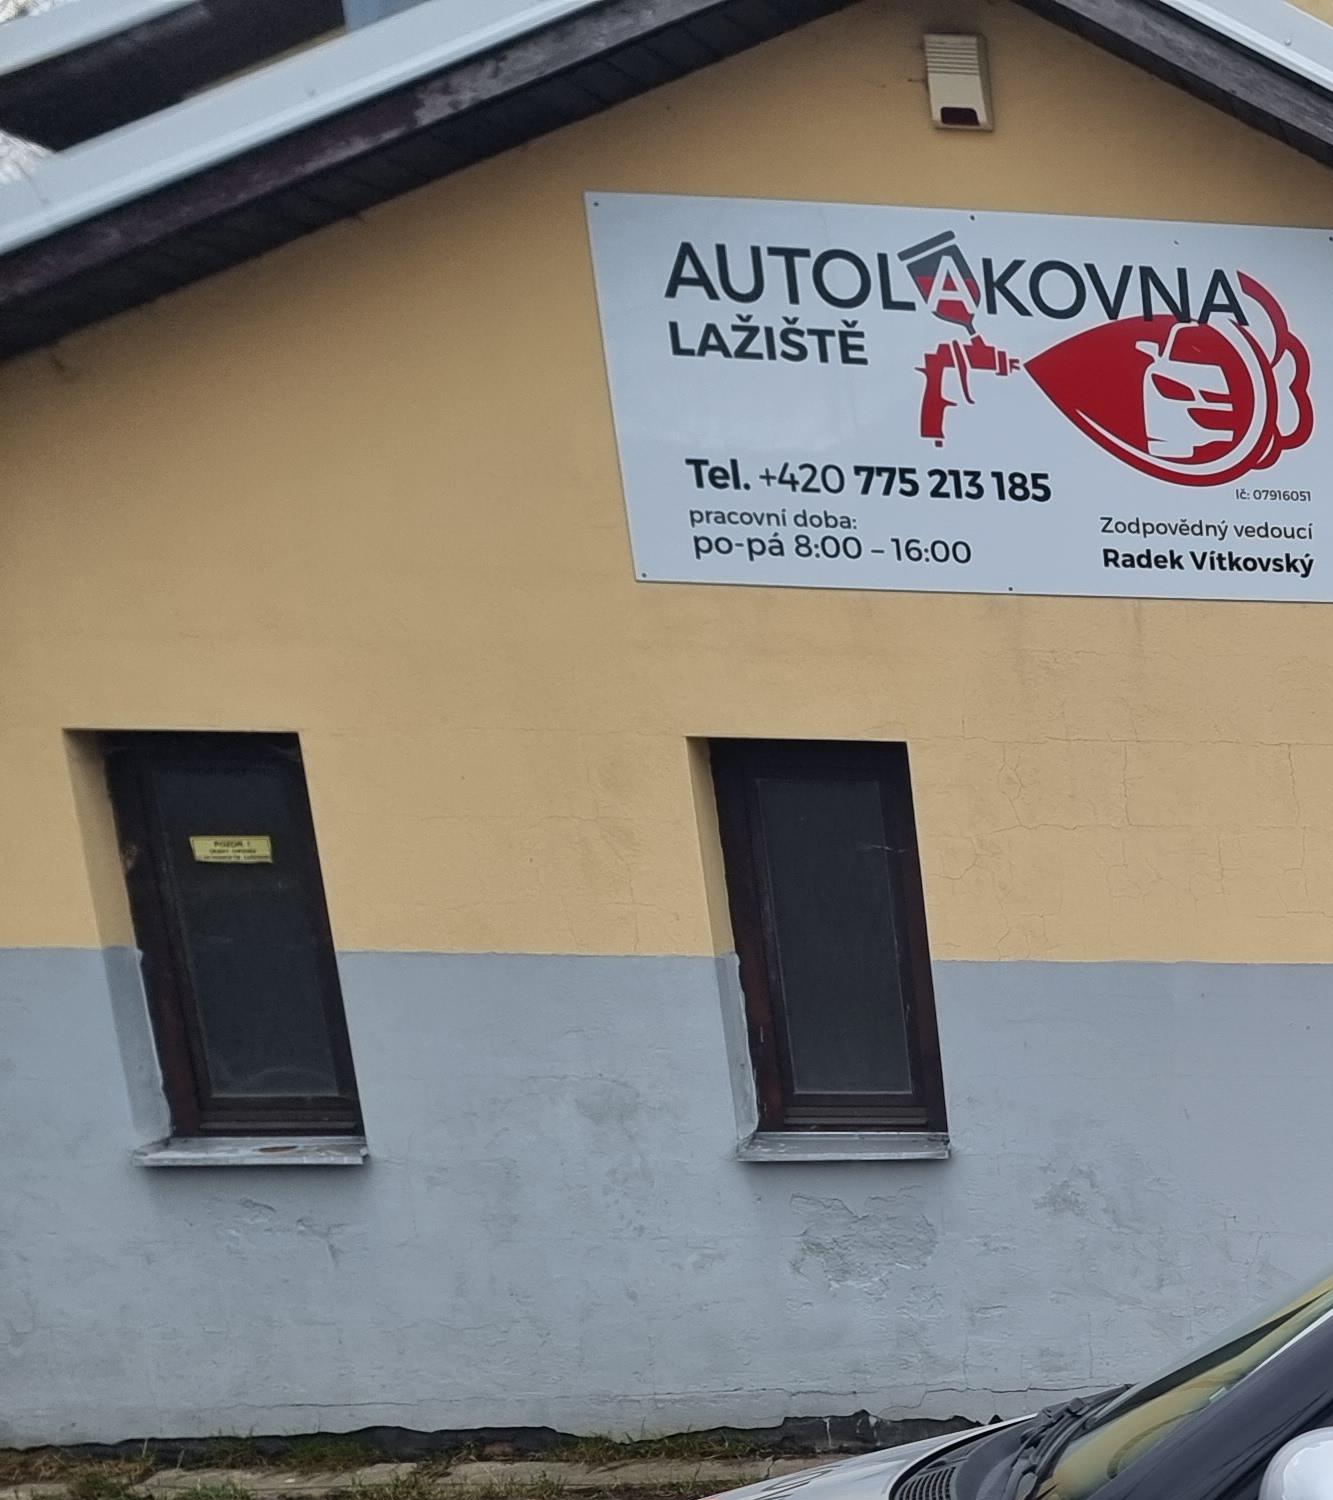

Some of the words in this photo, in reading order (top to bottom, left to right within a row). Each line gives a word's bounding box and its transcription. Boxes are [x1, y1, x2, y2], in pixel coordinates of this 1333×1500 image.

[664, 241, 1249, 326] AUTOLAKOVNA
[668, 313, 869, 366] LAŽIŠTĚ
[684, 458, 751, 491] Tel.
[758, 462, 845, 495] +420
[853, 465, 920, 498] 775
[927, 468, 985, 501] 213
[990, 470, 1052, 503] 185
[1252, 489, 1312, 502] 07916051
[689, 508, 787, 528] pracovní
[793, 508, 857, 530] doba:
[1099, 516, 1229, 542] Zodpovědný
[1232, 521, 1313, 540] vedoucí
[693, 531, 785, 562] po-pá
[794, 534, 862, 560] 8:00
[890, 537, 972, 564] 16:00
[1102, 548, 1185, 571] Radek
[1189, 550, 1314, 579] Vítkovský
